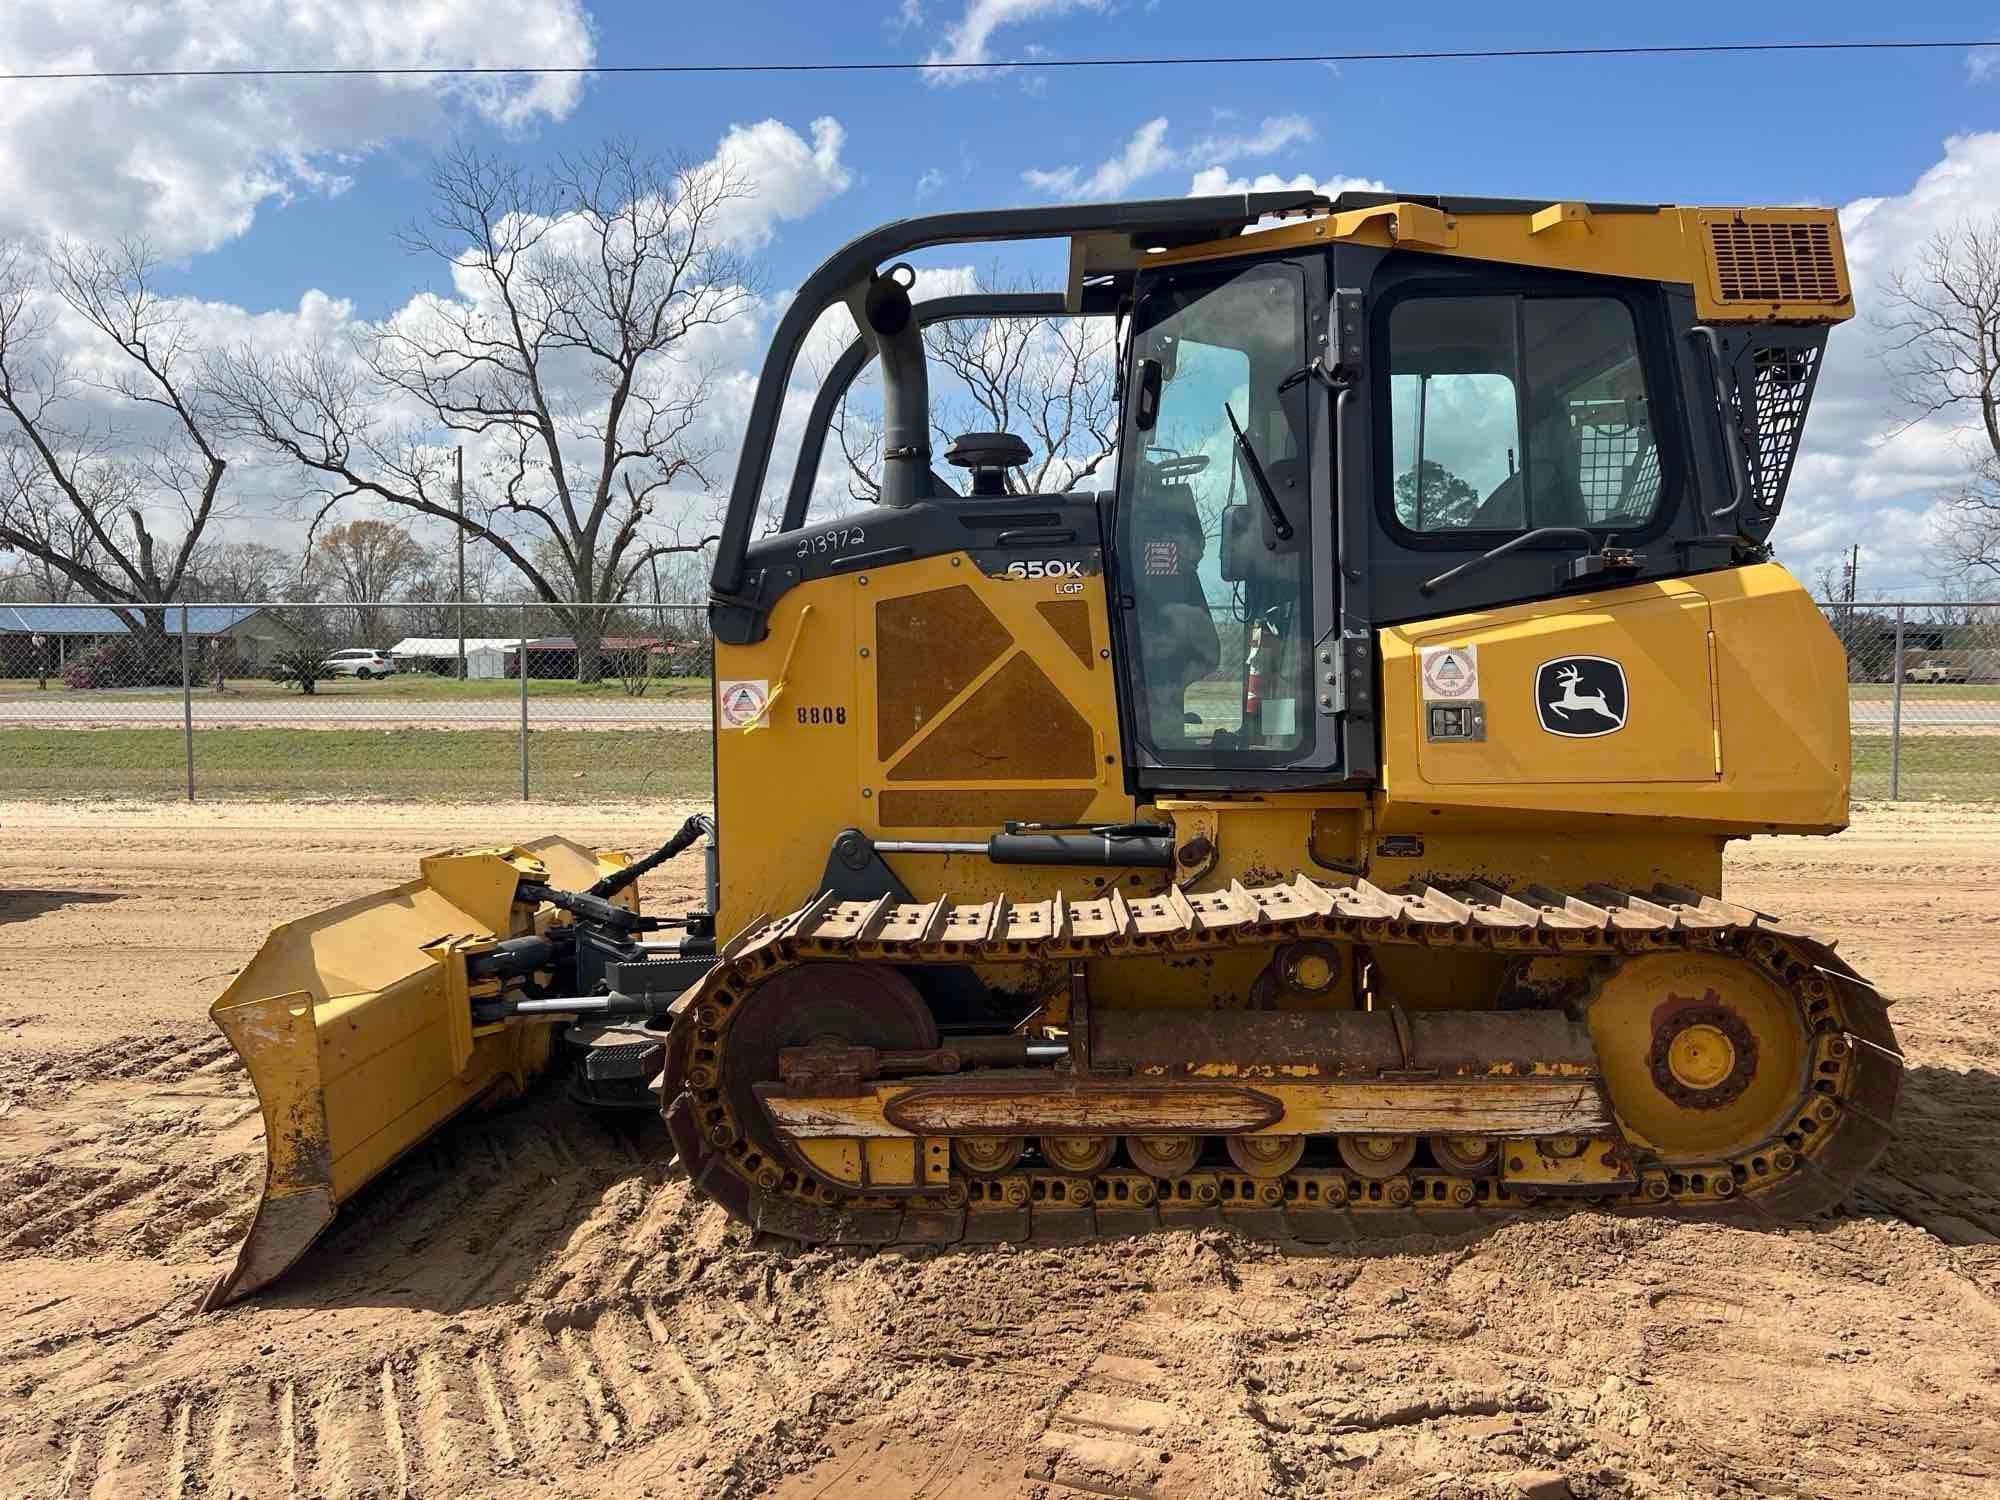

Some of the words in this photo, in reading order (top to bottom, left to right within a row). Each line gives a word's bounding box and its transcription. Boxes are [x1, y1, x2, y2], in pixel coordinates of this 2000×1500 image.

[796, 526, 865, 558] 213972
[1007, 560, 1082, 579] 650K
[1055, 583, 1084, 594] LGP
[797, 706, 846, 724] 8808
